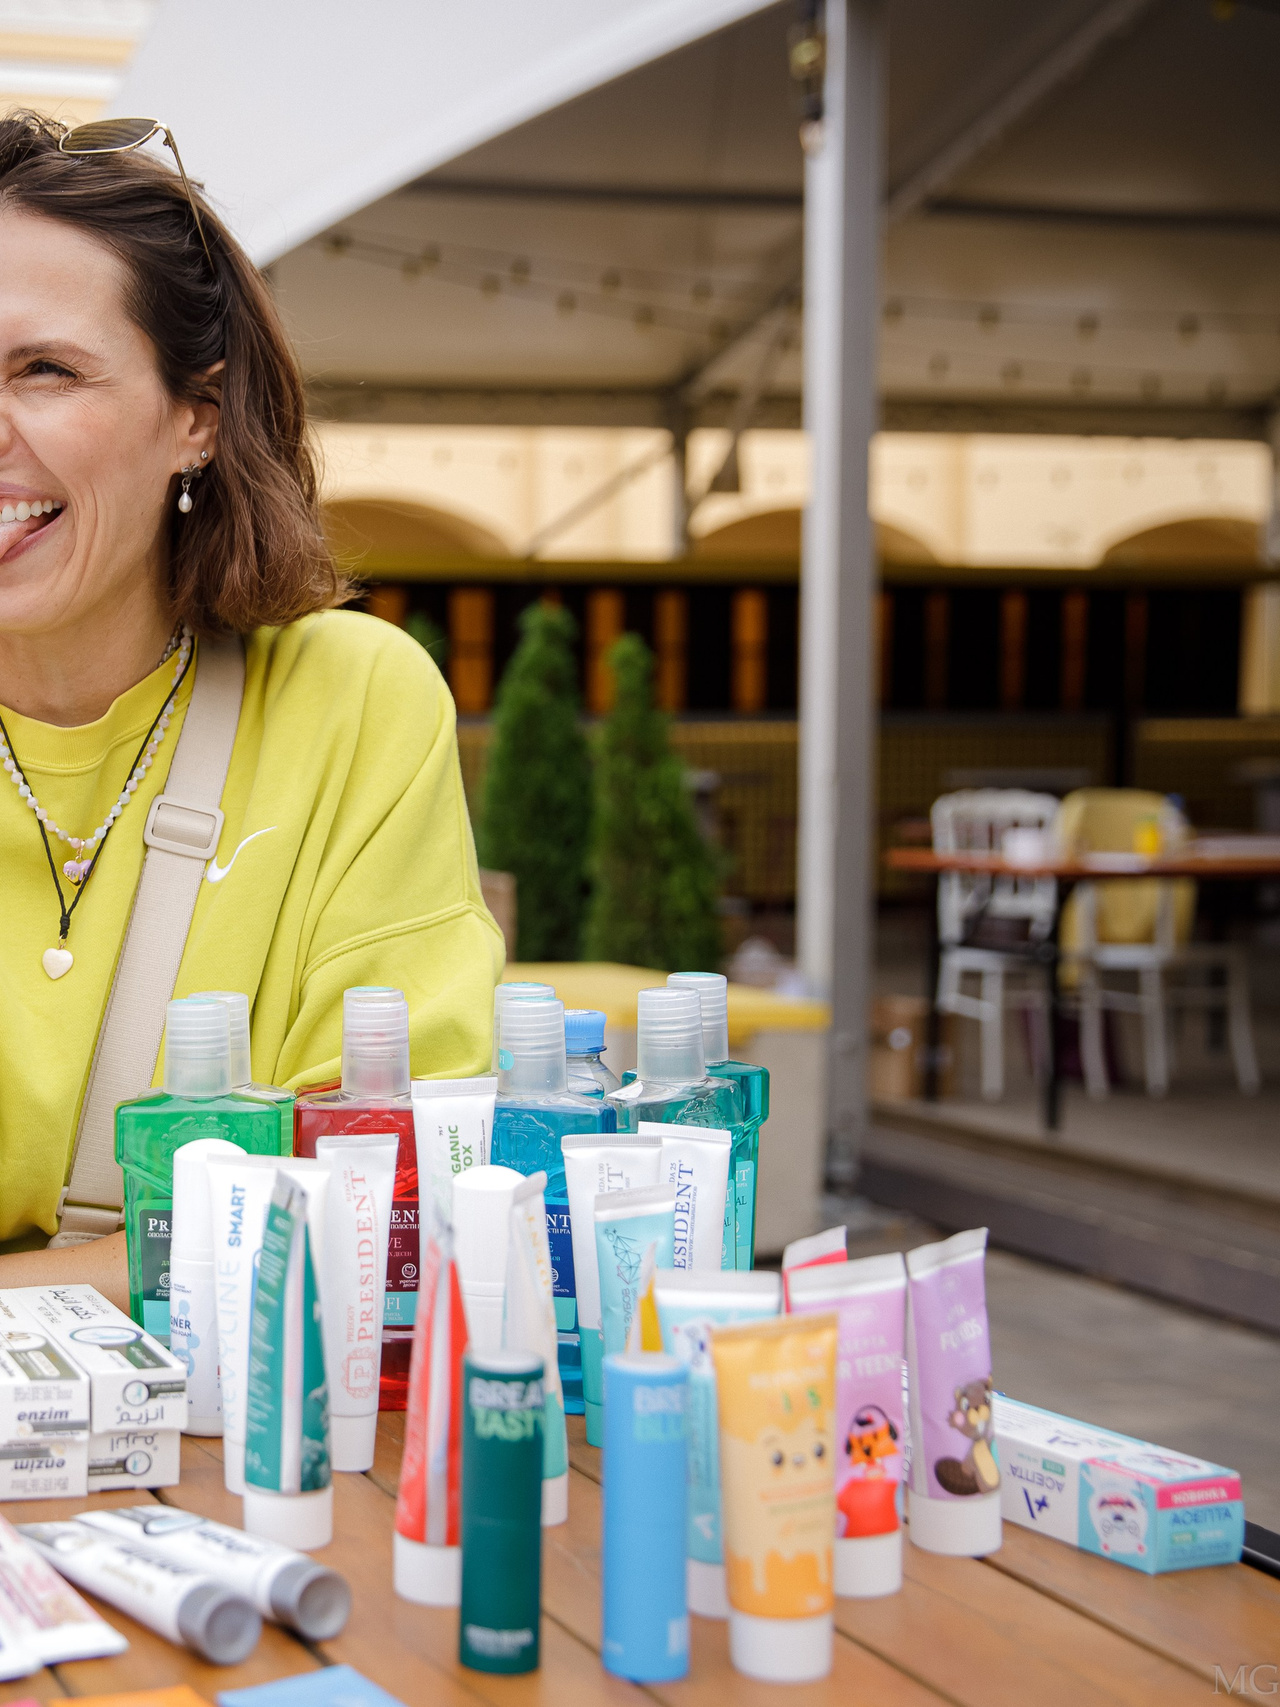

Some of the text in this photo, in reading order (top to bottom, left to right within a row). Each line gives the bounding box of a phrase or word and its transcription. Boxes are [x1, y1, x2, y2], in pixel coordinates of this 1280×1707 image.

[448, 1125, 461, 1174] GANIC
[462, 1144, 473, 1168] OX
[671, 1162, 676, 1171] 25
[147, 1218, 172, 1231] PR
[228, 1184, 246, 1248] SMART
[390, 1210, 419, 1222] EN
[350, 1170, 374, 1342] PRESIDENT
[385, 1297, 400, 1310] FI
[621, 1288, 632, 1323] ЗУБОВ
[346, 1303, 355, 1343] PREGGY
[17, 1407, 70, 1421] enzim
[14, 1457, 66, 1473] enzim
[1172, 1487, 1228, 1504] НОВИНКА
